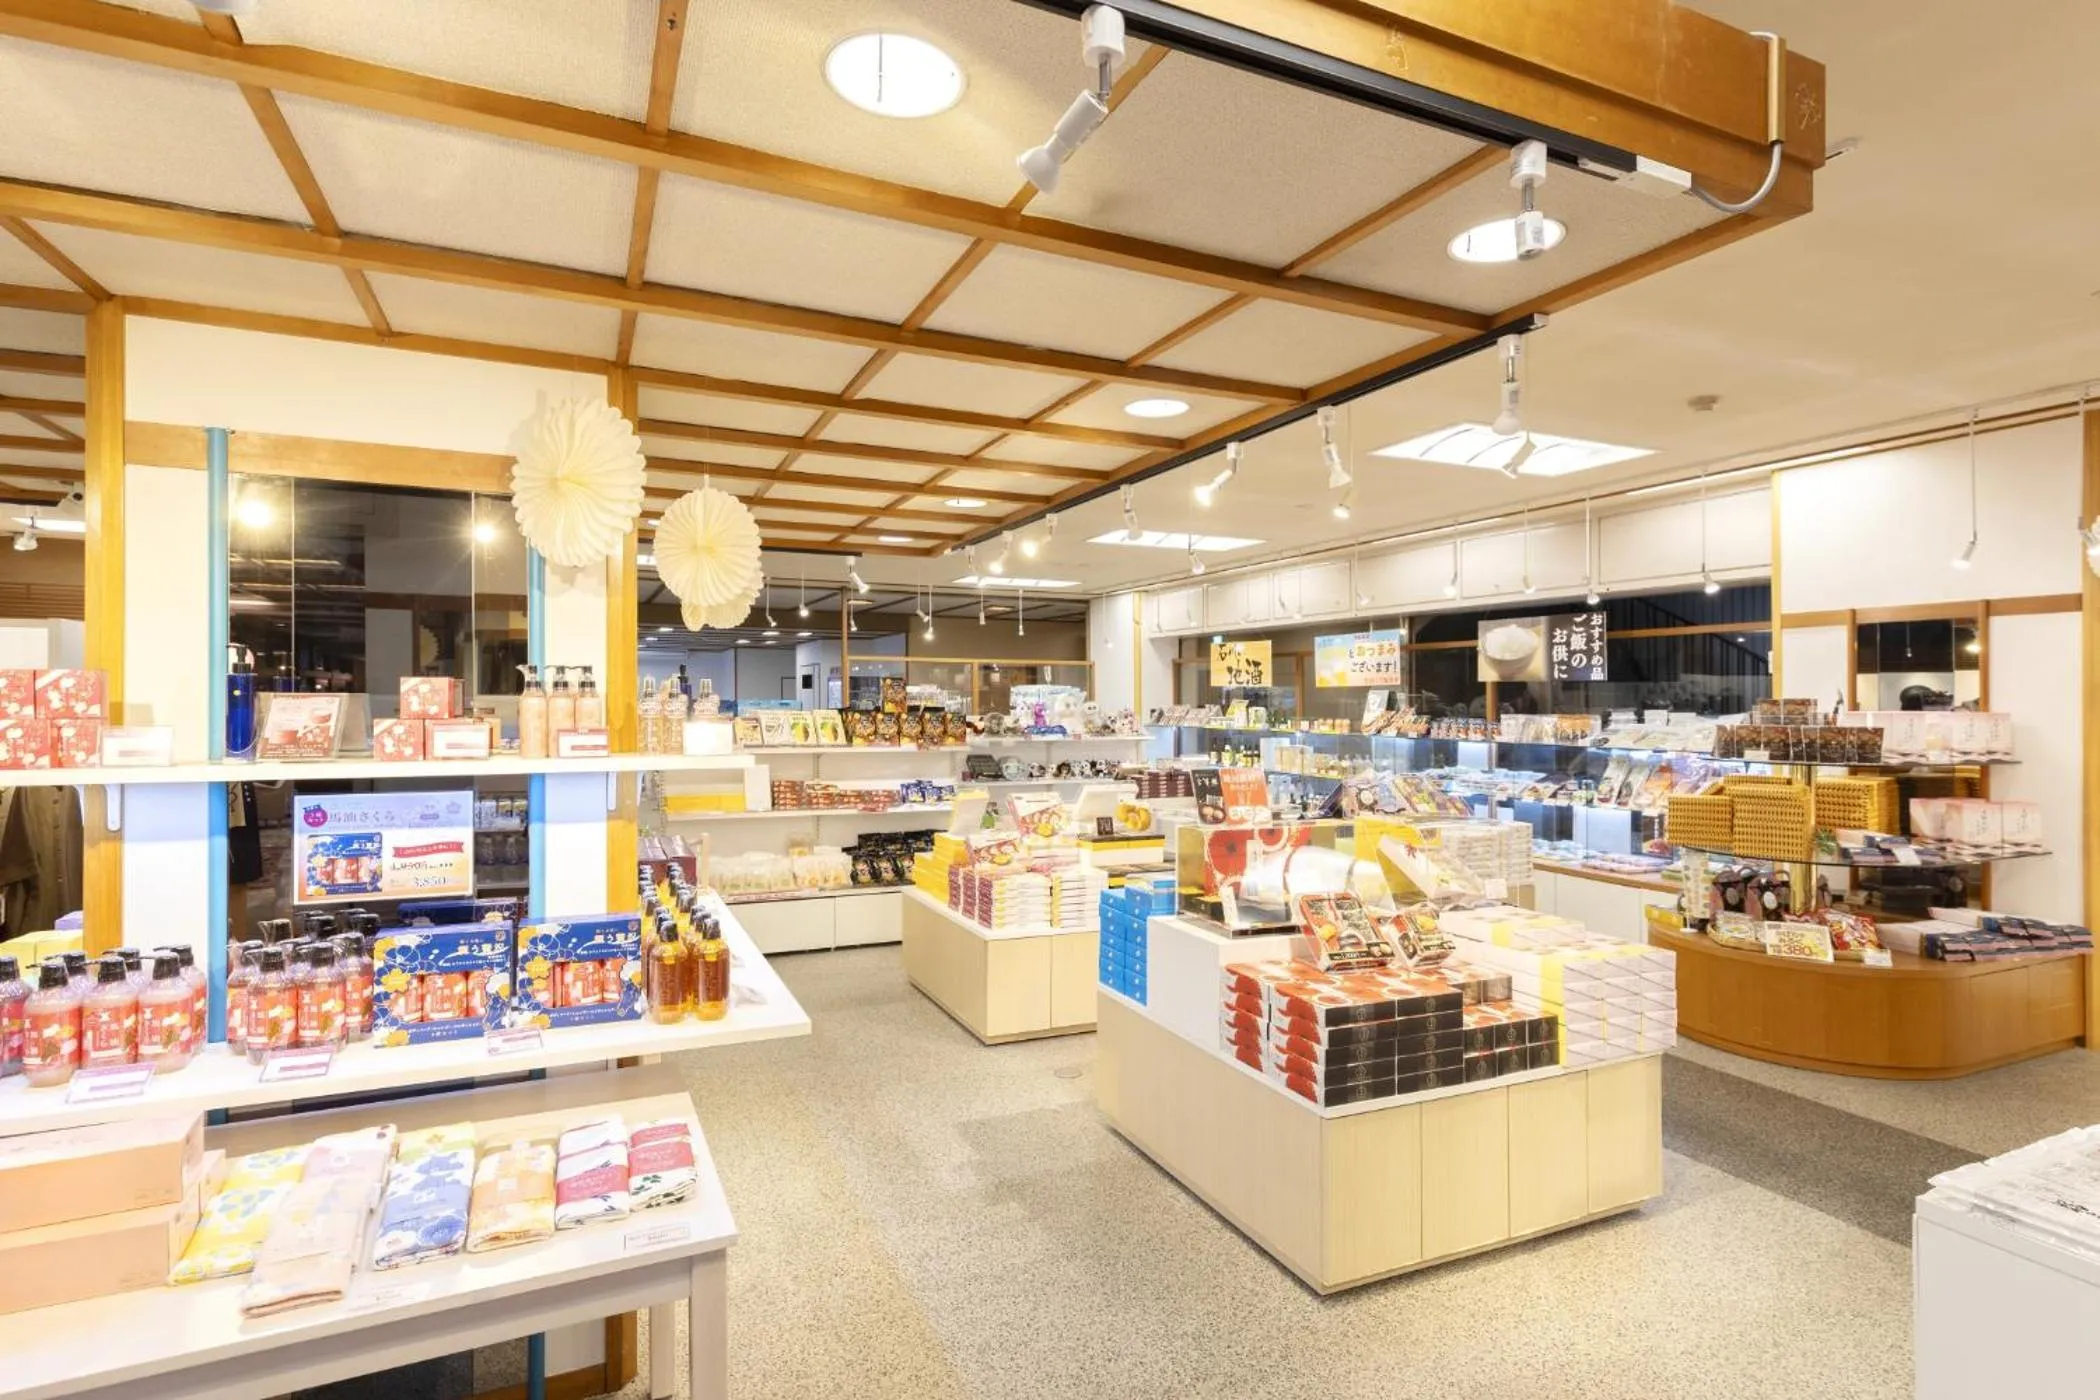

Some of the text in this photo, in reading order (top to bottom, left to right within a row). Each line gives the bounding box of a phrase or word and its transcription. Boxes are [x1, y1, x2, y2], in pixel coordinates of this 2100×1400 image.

[1552, 627, 1569, 680] お供に
[1570, 613, 1587, 669] ご飯の
[1590, 613, 1604, 681] おすすめ品
